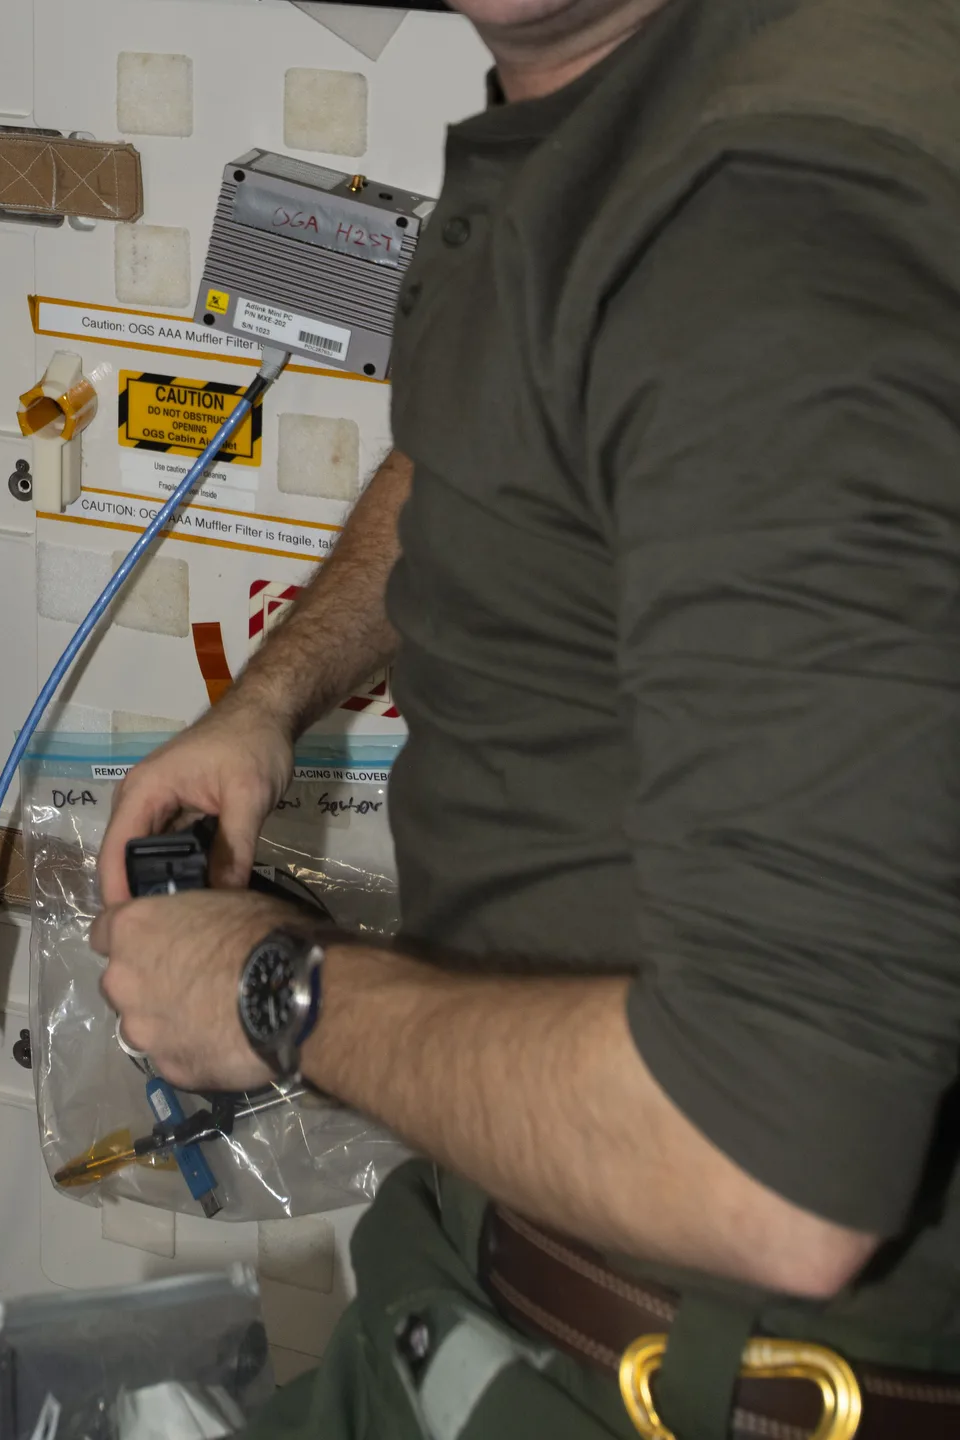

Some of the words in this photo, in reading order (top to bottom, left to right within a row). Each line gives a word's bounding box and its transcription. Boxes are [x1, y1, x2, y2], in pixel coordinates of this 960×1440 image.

[270, 205, 322, 236] OGA
[334, 220, 394, 252] H2ST
[243, 309, 256, 319] P/N
[256, 313, 287, 328] MXE-202
[244, 301, 267, 314] Adlink
[266, 307, 283, 318] Mini
[282, 312, 293, 321] PC
[80, 315, 125, 332] Caution:
[127, 322, 155, 336] OGS
[157, 326, 183, 340] AAA
[184, 330, 223, 346] Muffler
[225, 335, 254, 350] Filter
[240, 321, 253, 330] S/N
[254, 325, 271, 336] 1023
[153, 385, 225, 410] CAUTION
[146, 405, 161, 415] DO
[162, 407, 181, 418] NOT
[141, 427, 165, 438] OGS
[166, 431, 196, 444] Cabin
[171, 420, 207, 434] OPENING
[153, 461, 165, 471] Use
[165, 463, 187, 474] caution
[199, 487, 218, 499] Inside
[81, 499, 135, 518] CAUTION:
[167, 512, 192, 527] AAA
[193, 516, 233, 534] Muffler
[234, 523, 265, 539] Filter
[264, 528, 275, 541] is
[276, 531, 316, 548] fragile,
[317, 538, 335, 551] tak
[293, 769, 330, 778] LACING
[333, 770, 343, 778] IN
[345, 771, 388, 781] GLOVEB
